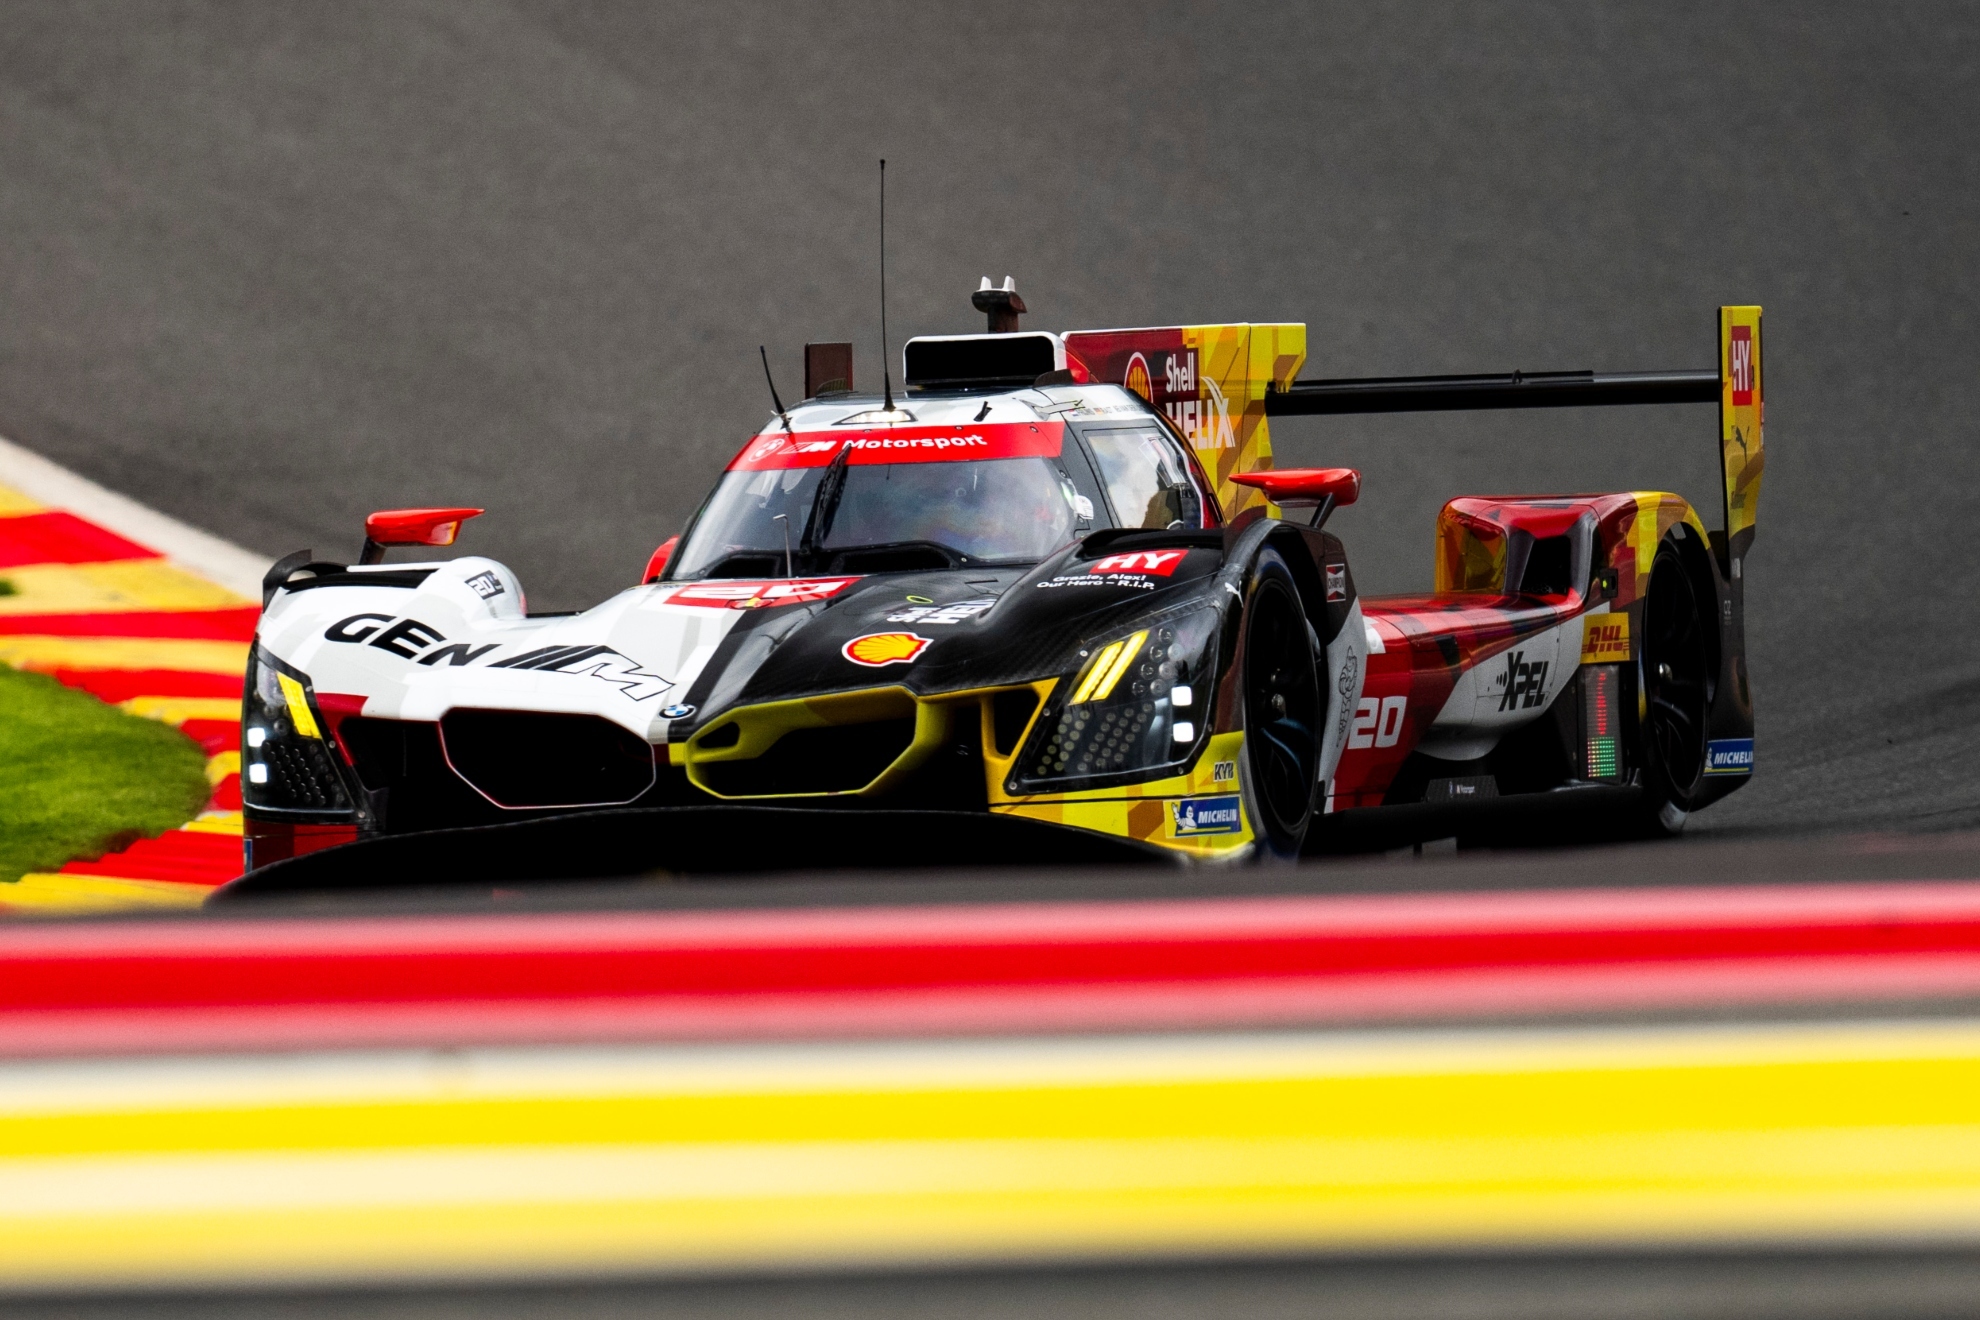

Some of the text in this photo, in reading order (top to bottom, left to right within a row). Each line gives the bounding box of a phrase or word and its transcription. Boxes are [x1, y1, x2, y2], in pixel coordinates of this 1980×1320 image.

[1166, 352, 1195, 393] Shell
[1732, 340, 1750, 391] HY
[842, 434, 988, 450] Motorsport
[1097, 552, 1180, 569] HY
[1036, 580, 1066, 588] Our
[1066, 580, 1103, 588] Hero
[1117, 580, 1155, 589] R.I.P.
[1052, 573, 1147, 582] Grazie, Alex!
[324, 613, 503, 666] GEN
[1586, 625, 1622, 654] DHL
[1498, 651, 1549, 712] XPEL
[1347, 696, 1408, 750] 20
[1214, 762, 1234, 781] KYB
[1197, 808, 1238, 824] MICHELIN
